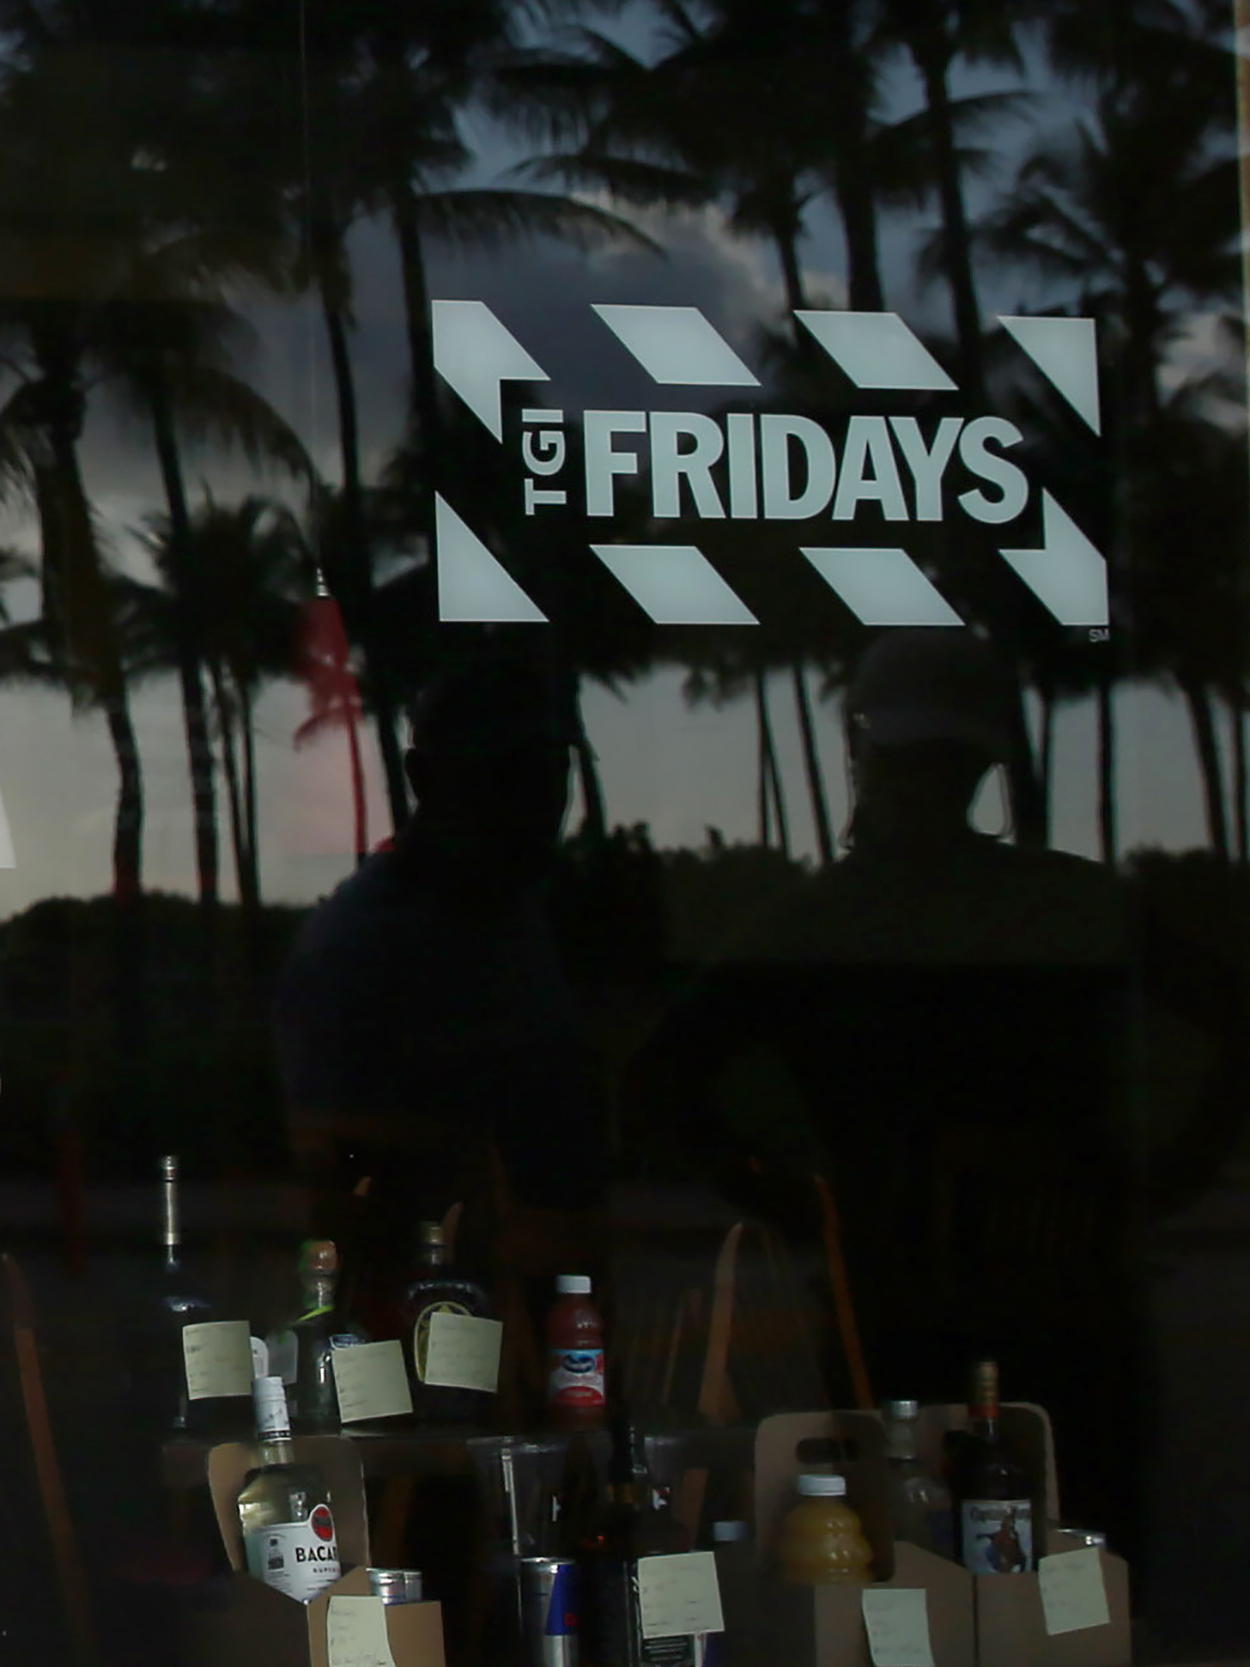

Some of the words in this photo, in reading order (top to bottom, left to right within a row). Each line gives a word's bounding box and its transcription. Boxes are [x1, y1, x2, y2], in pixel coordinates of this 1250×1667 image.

[521, 408, 567, 515] TGI
[583, 409, 1029, 524] FRIDAYS
[1089, 628, 1110, 642] SM
